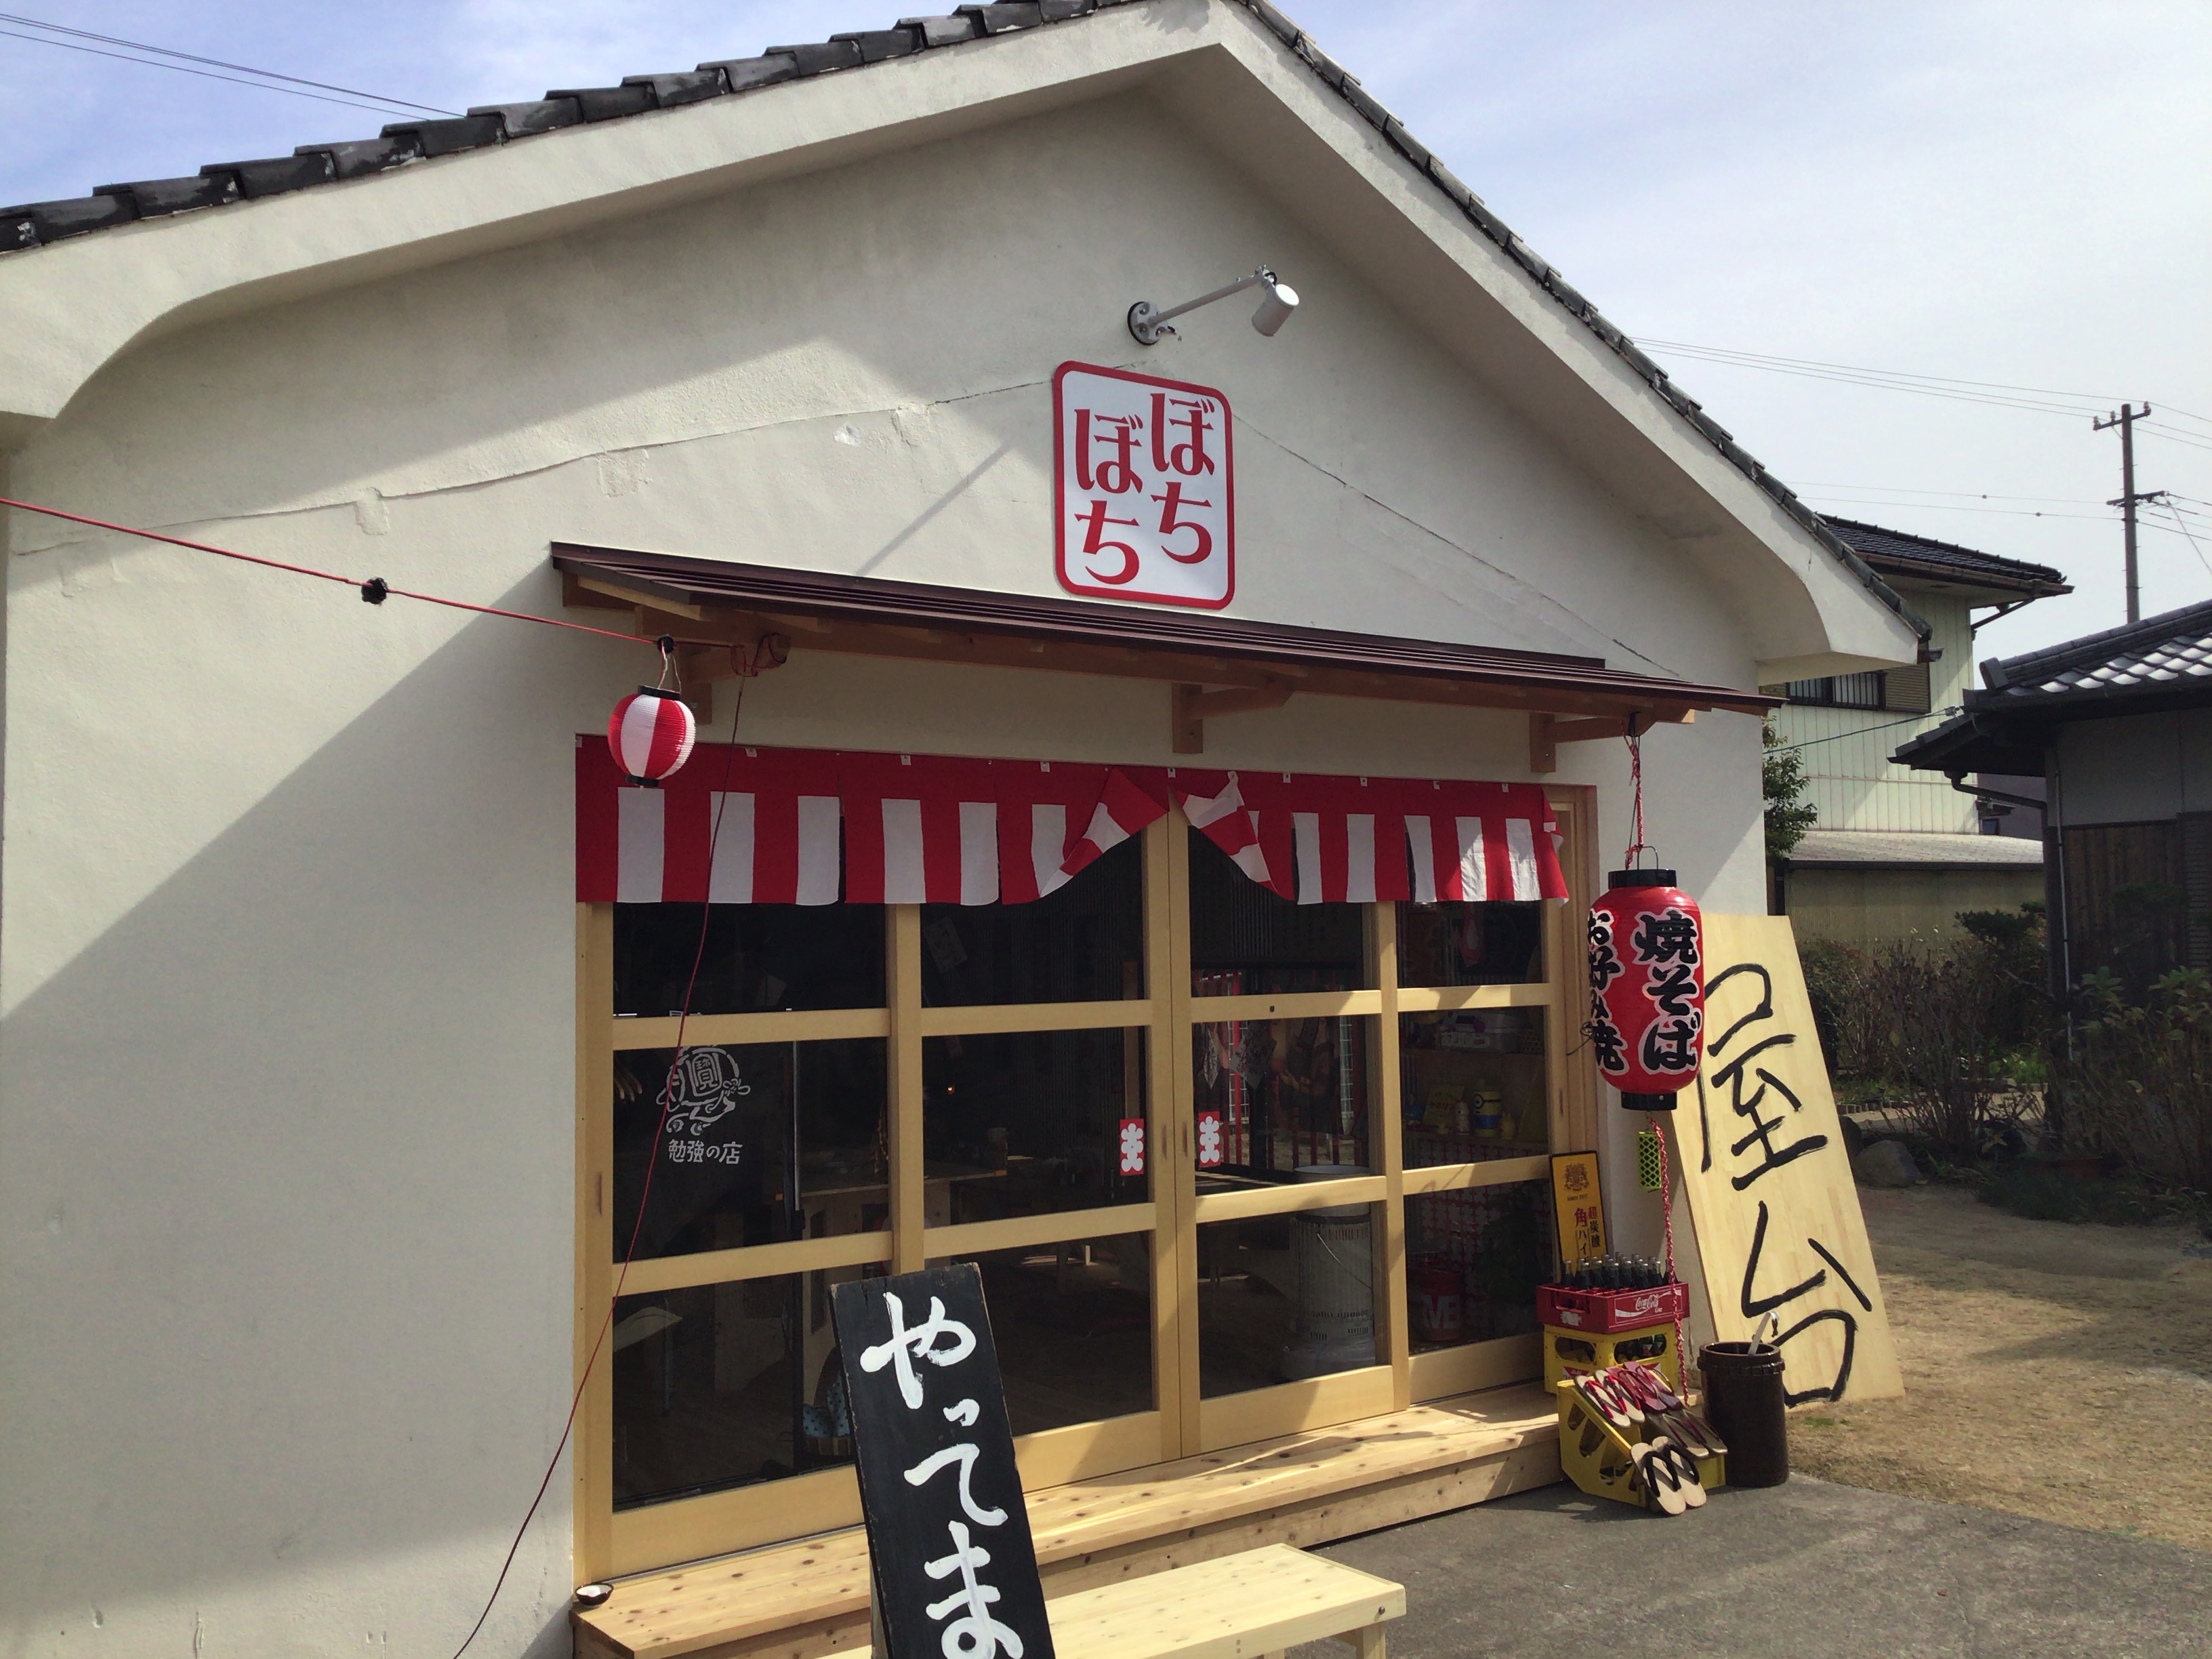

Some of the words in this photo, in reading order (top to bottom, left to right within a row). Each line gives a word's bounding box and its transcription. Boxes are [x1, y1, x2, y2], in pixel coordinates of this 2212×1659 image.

[1074, 409, 1144, 585] ぼち
[1150, 392, 1215, 564] ぼち
[1633, 908, 1702, 1072] 焼そば
[668, 1139, 743, 1164] 勉強の店
[1574, 1206, 1589, 1262] 角ハイ
[1698, 963, 1872, 1408] 屋台
